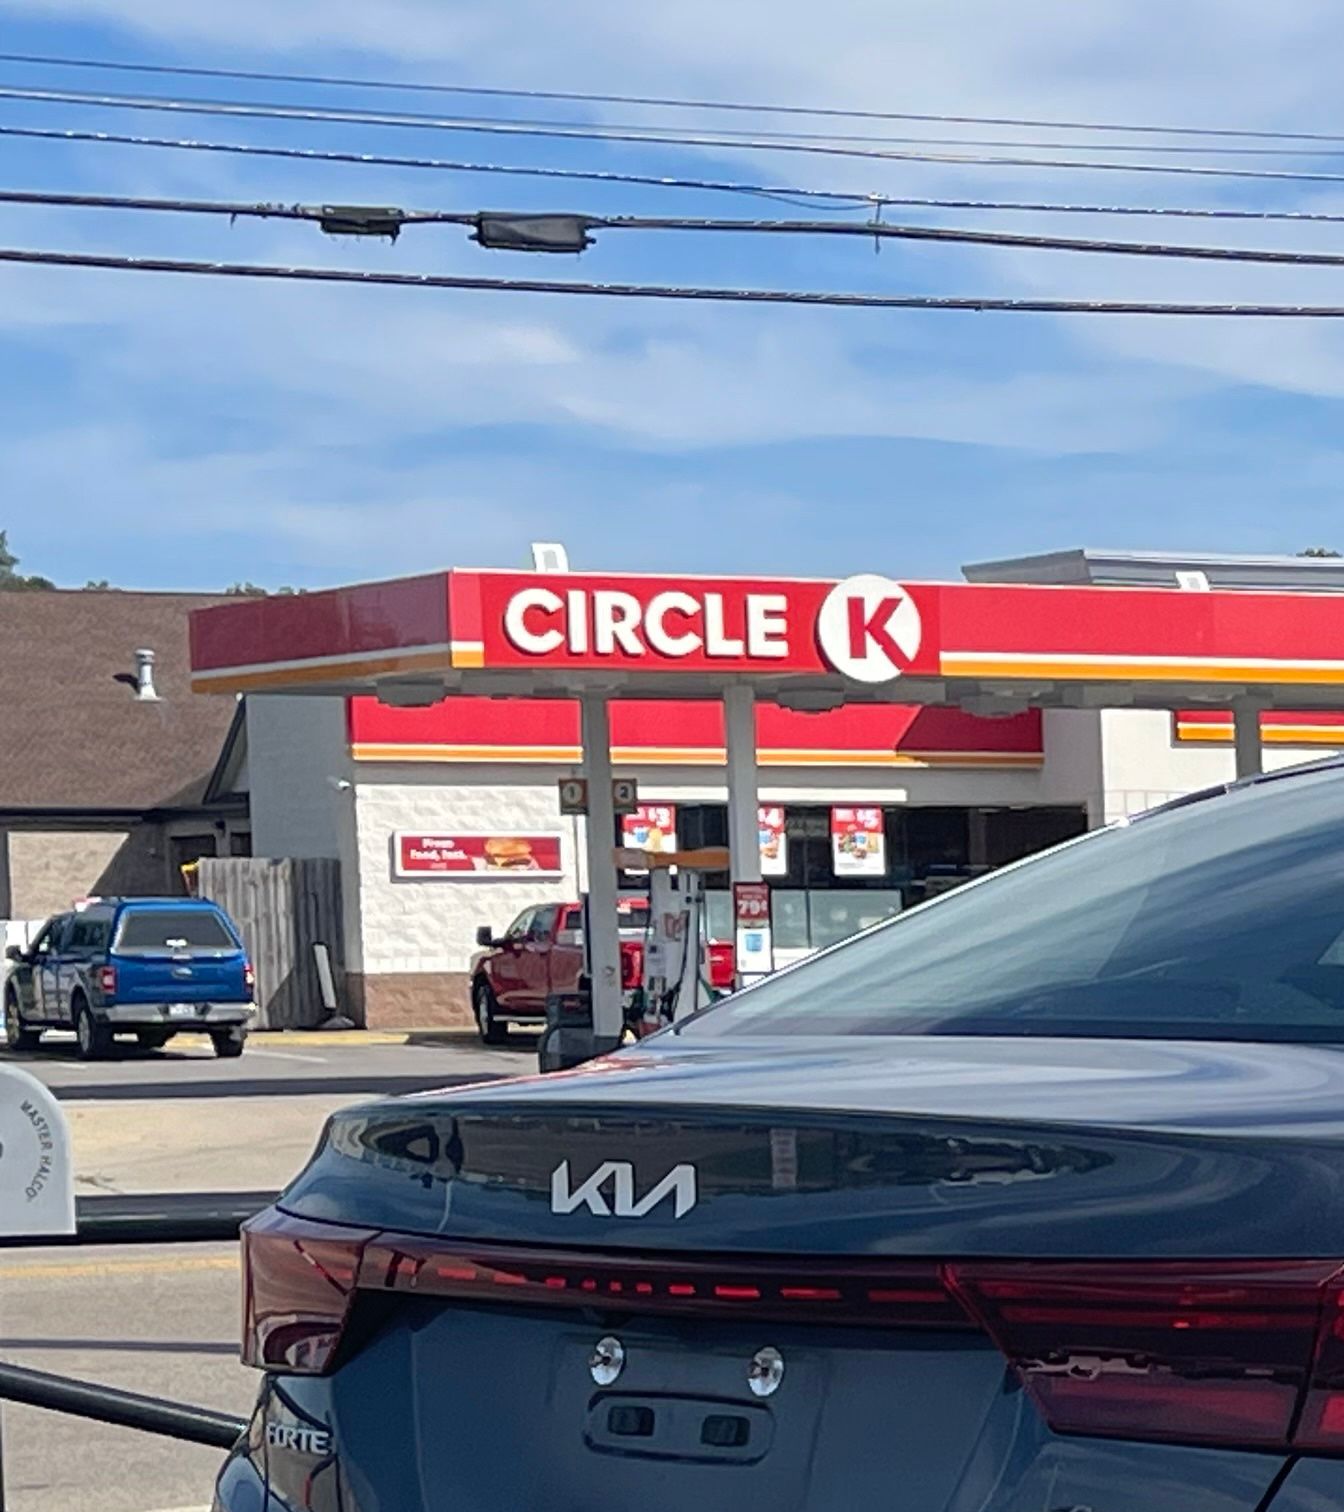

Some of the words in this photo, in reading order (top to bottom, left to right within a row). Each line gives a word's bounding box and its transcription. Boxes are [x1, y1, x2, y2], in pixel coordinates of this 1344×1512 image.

[504, 587, 790, 659] CIRCLE
[846, 596, 914, 671] K
[20, 1100, 54, 1151] MASTER
[551, 1159, 697, 1219] KIA
[265, 1421, 330, 1456] FORTE
